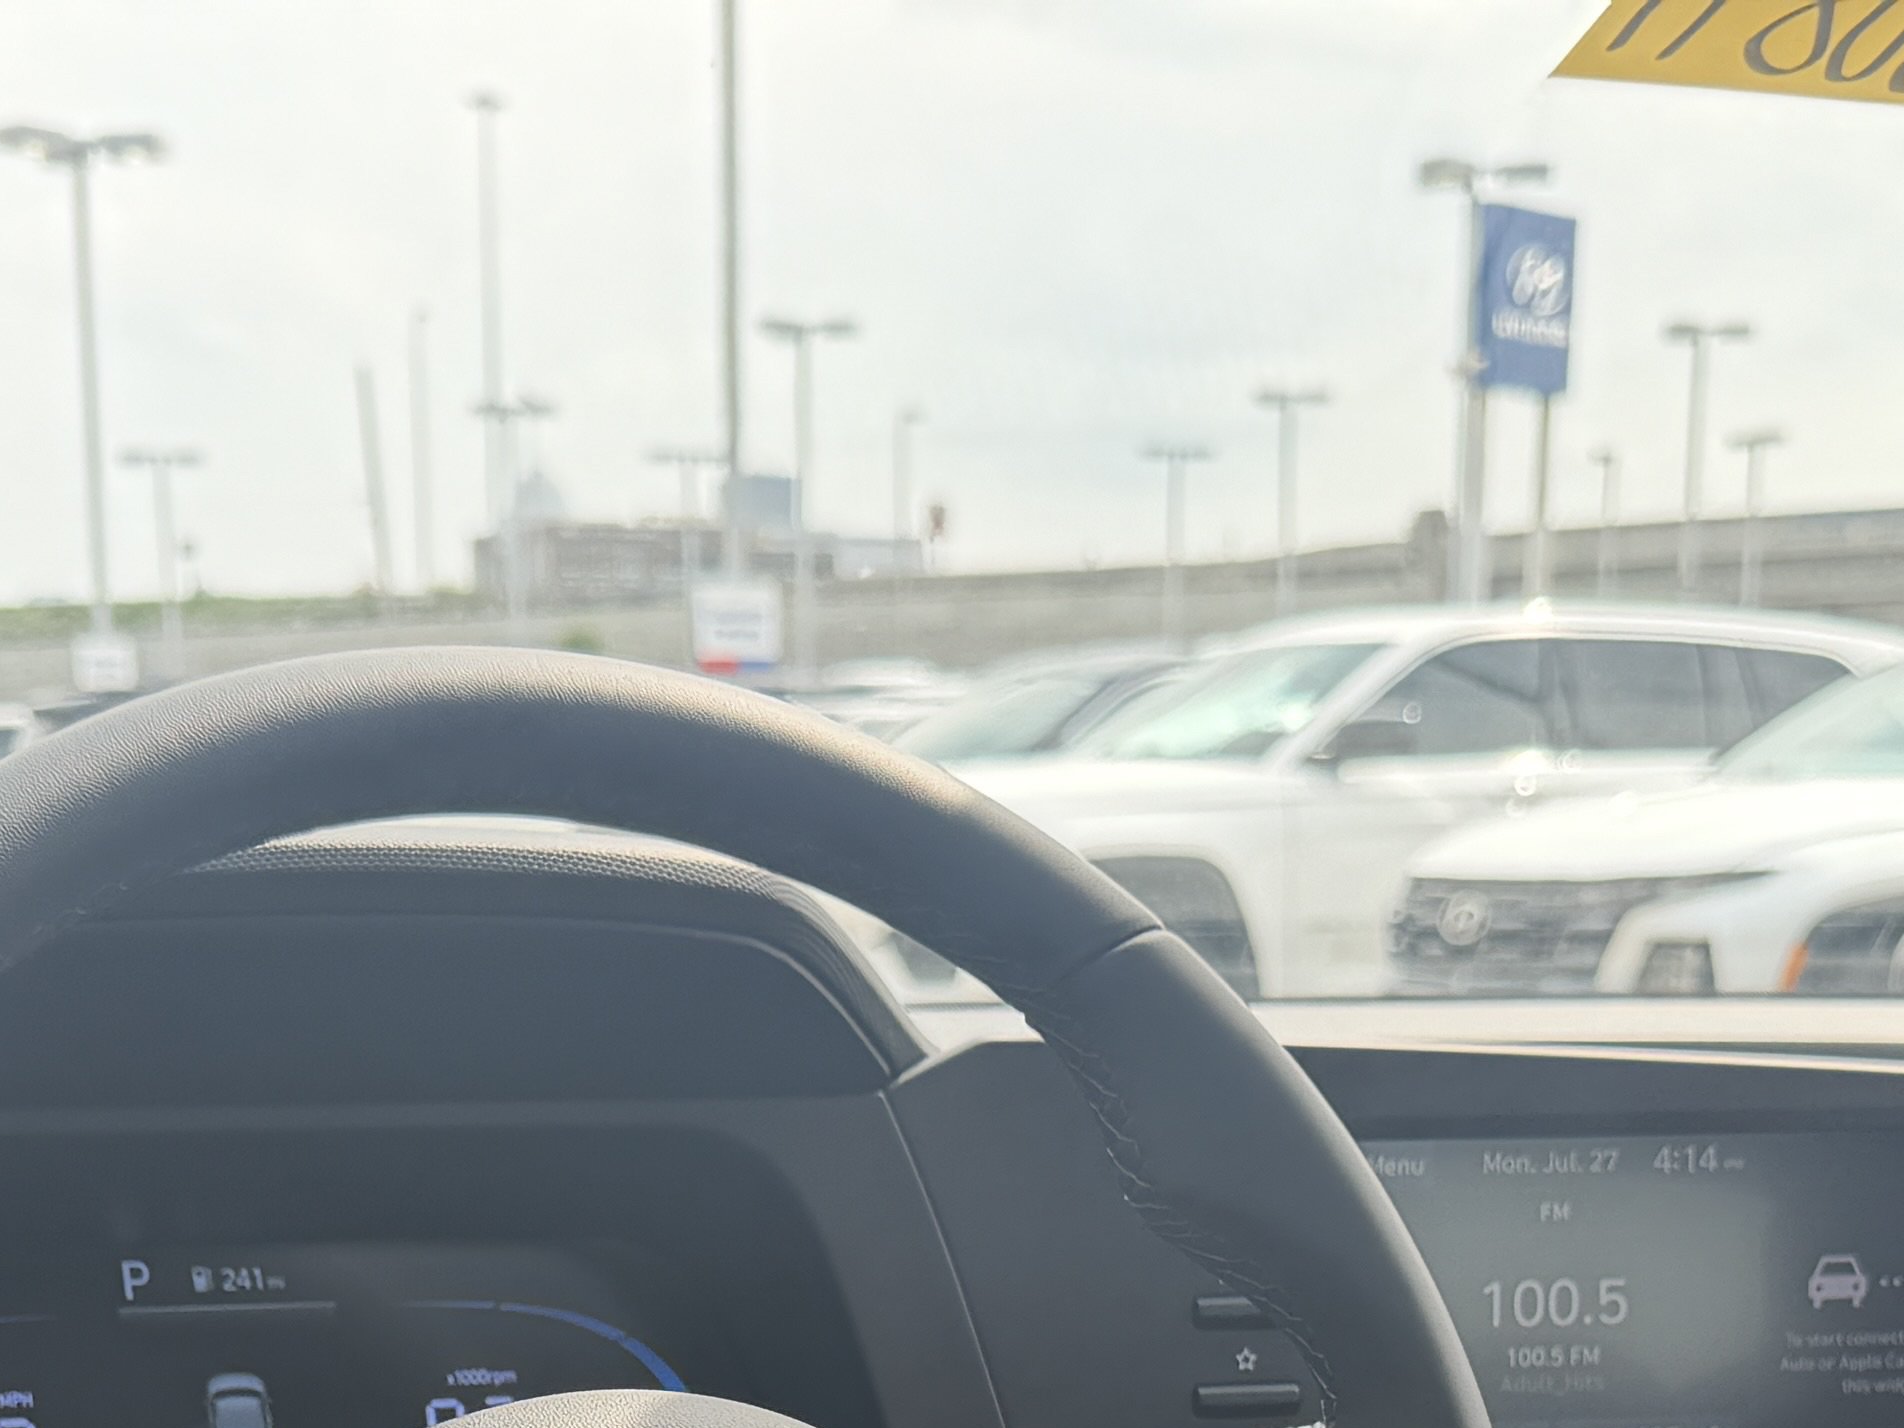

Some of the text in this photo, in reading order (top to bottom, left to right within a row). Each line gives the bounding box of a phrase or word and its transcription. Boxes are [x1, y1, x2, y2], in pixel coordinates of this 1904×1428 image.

[1589, 1148, 1620, 1173] 27
[1653, 1144, 1719, 1175] 4:14
[1540, 1201, 1572, 1222] FM
[120, 1259, 151, 1301] P
[219, 1266, 265, 1292] 241
[1483, 1277, 1629, 1328] 100.5
[1508, 1345, 1600, 1369] 100.5 FM
